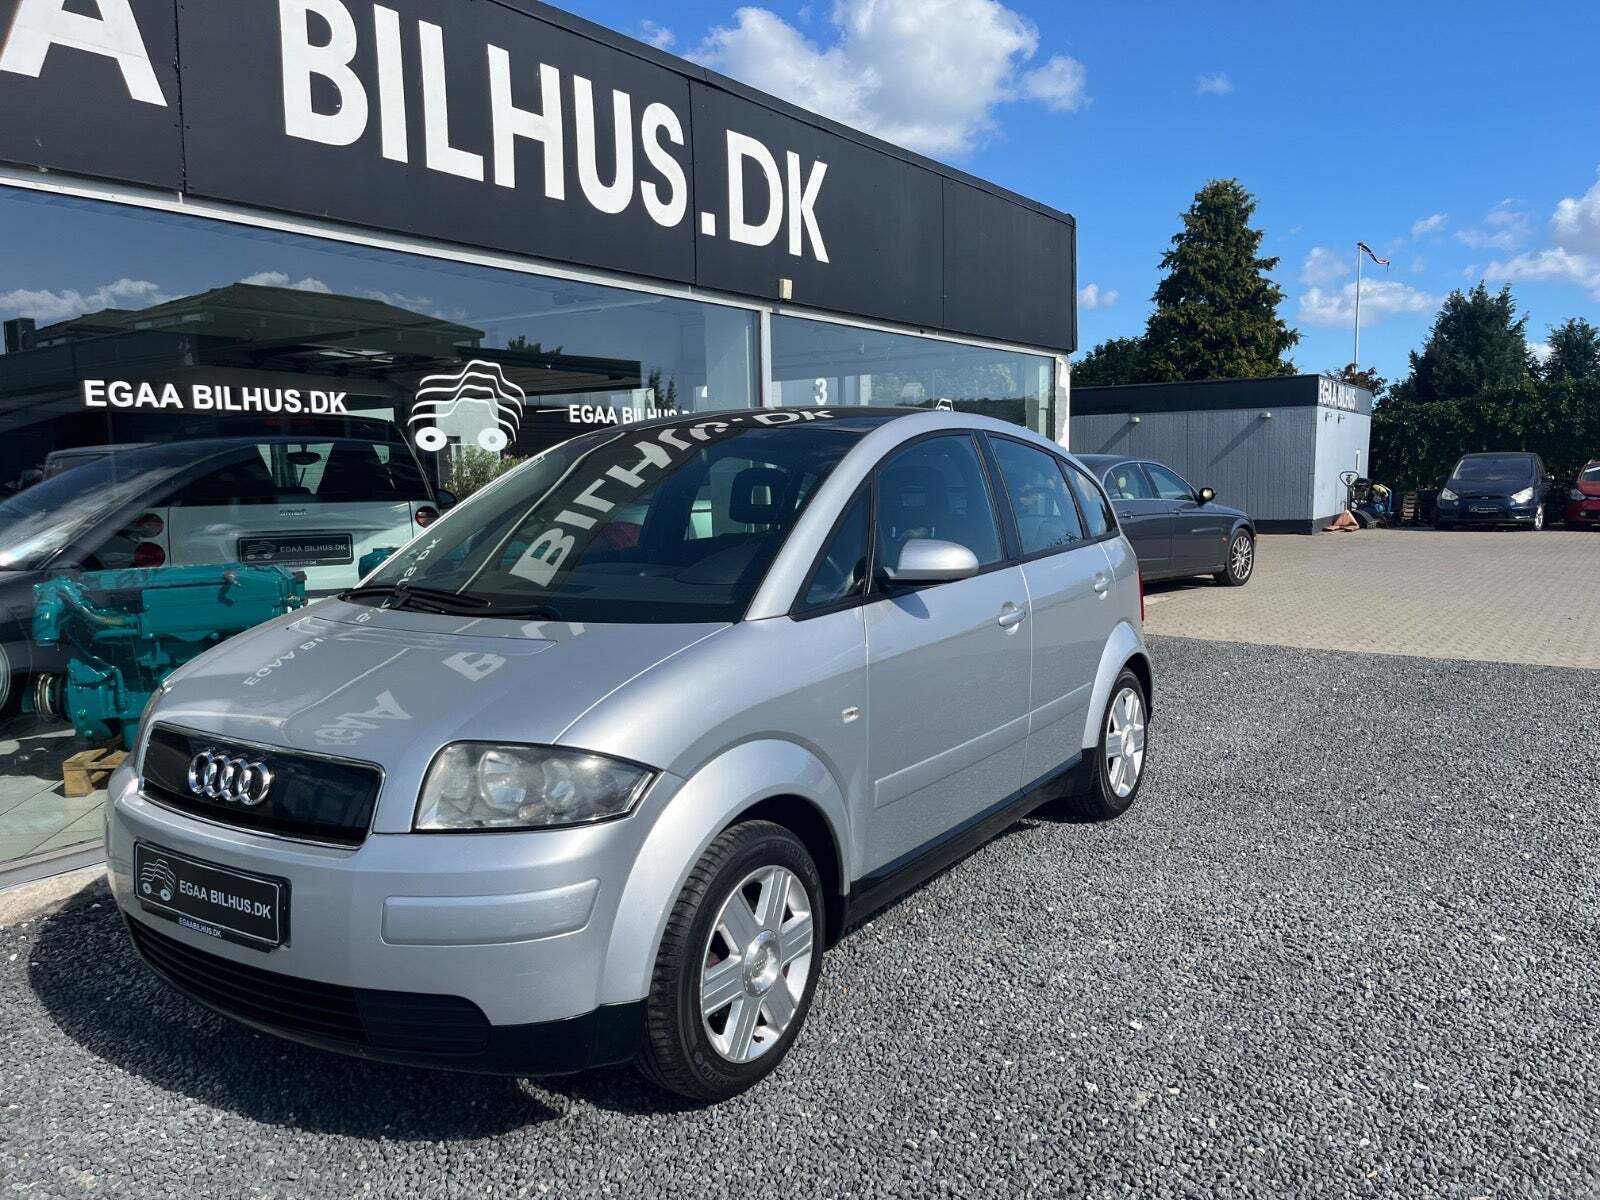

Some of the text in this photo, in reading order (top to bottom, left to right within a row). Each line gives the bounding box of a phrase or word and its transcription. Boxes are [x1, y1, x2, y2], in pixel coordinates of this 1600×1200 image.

[279, 0, 831, 264] BILHUS.DK
[84, 379, 348, 415] EGAA BILHUS.DK
[814, 377, 828, 406] 3
[569, 404, 618, 424] EGAA
[179, 880, 272, 919] EGAA BILHUS.DK
